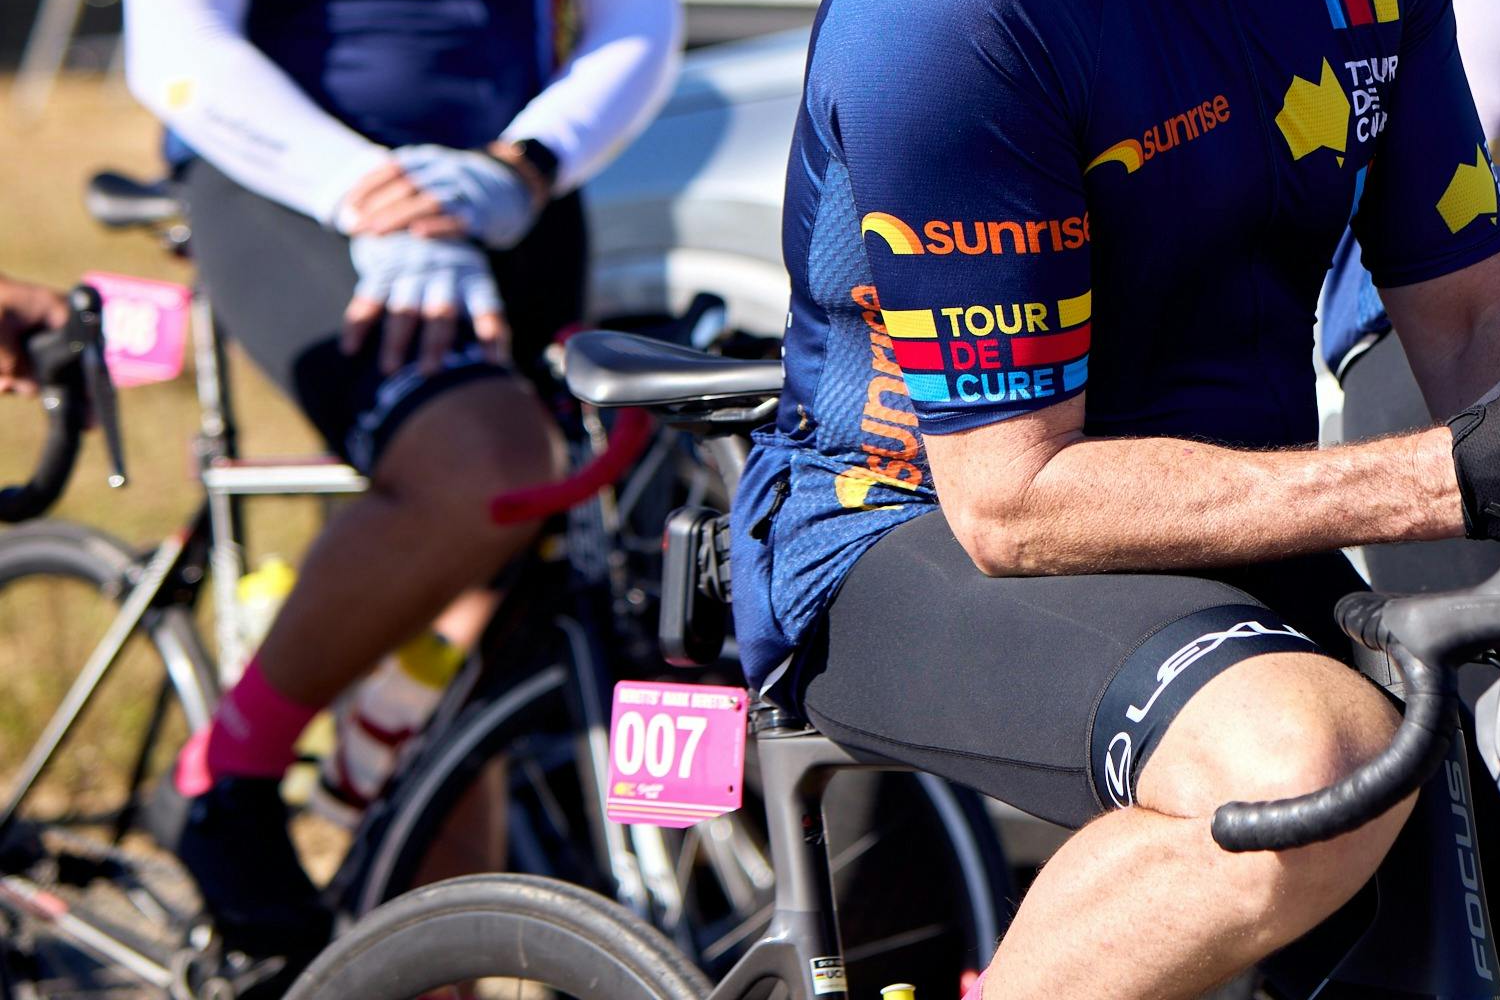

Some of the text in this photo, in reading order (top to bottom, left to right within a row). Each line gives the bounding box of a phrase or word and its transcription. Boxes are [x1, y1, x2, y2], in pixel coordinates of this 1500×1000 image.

[1143, 94, 1231, 161] sunrise
[941, 302, 1048, 338] TOUR
[949, 339, 1002, 371] DE
[956, 368, 1056, 403] CURE
[1125, 621, 1321, 723] LEXU
[614, 711, 708, 779] 007
[1445, 759, 1494, 982] FOCUS
